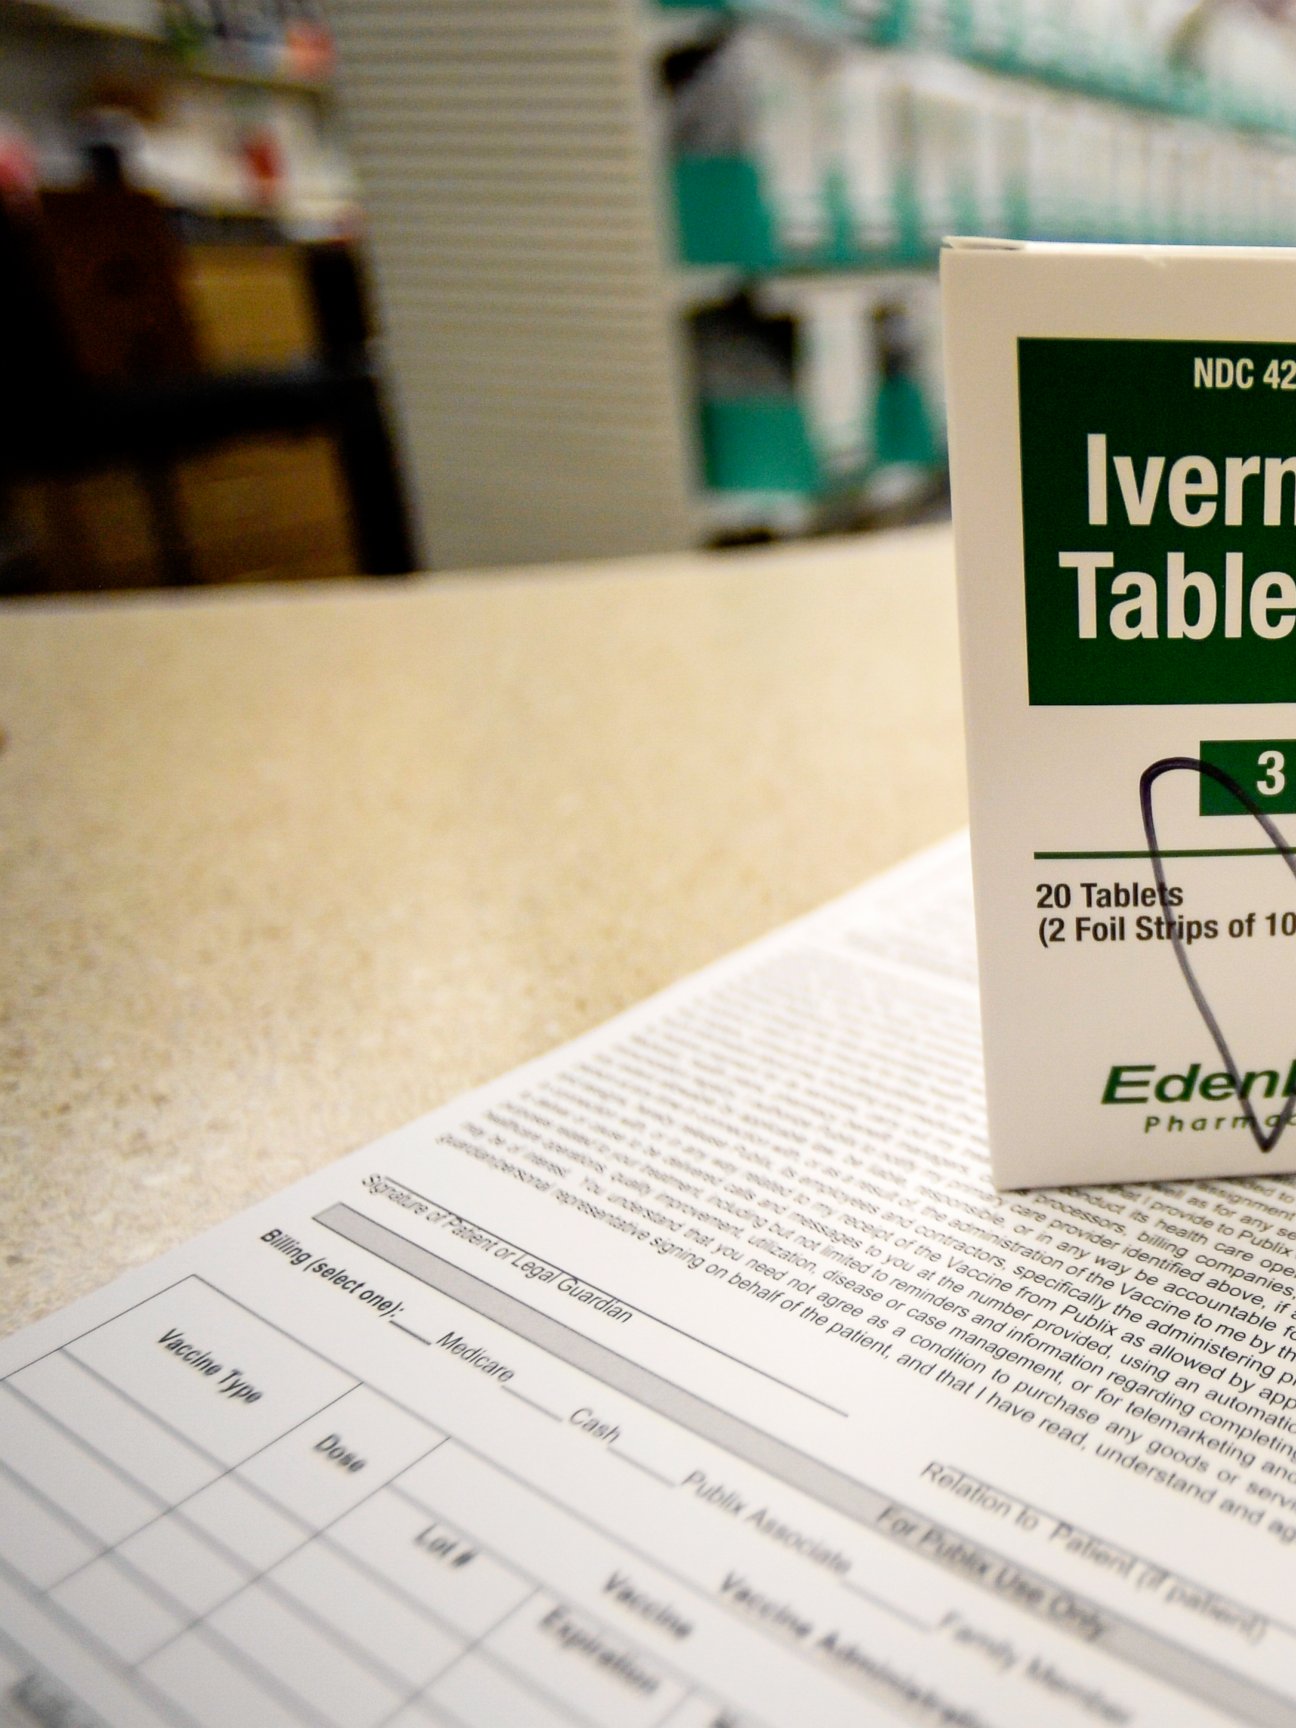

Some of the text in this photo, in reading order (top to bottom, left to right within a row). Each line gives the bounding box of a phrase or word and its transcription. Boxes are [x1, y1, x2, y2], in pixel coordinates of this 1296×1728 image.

[1193, 358, 1254, 389] NDC
[1257, 751, 1284, 797] 3
[1036, 882, 1184, 909] 20 Tablets
[1038, 918, 1066, 948] (2
[1075, 916, 1126, 942] Foil
[1135, 914, 1218, 945] Strips
[1228, 912, 1256, 938] of
[1265, 912, 1296, 937] 10
[362, 1172, 634, 1325] Signature of Patient or Legal Guardian
[1136, 1230, 1189, 1259] billing
[1194, 1253, 1296, 1300] companies,
[648, 1236, 706, 1270] signing
[704, 1263, 729, 1279] on
[726, 1271, 786, 1303] behalf
[779, 1298, 805, 1312] of
[798, 1305, 829, 1326] the
[824, 1321, 893, 1360] patient,
[895, 1353, 938, 1376] and
[934, 1368, 976, 1395] that
[984, 1390, 1036, 1423] have
[1084, 1270, 1115, 1290] the
[1119, 1281, 1191, 1320] Vaccine
[1192, 1312, 1213, 1329] to
[1213, 1323, 1247, 1342] me
[1248, 1333, 1277, 1355] by
[157, 1327, 263, 1406] Vaccine Type
[259, 1228, 312, 1266] Billing
[302, 1257, 366, 1294] (select
[358, 1289, 405, 1318] one):
[435, 1330, 515, 1383] Medicare
[568, 1407, 621, 1444] Cash
[680, 1469, 745, 1516] Publix
[746, 1507, 852, 1576] Associate
[821, 1269, 884, 1302] disease
[884, 1298, 907, 1311] or
[905, 1307, 947, 1330] case
[947, 1325, 1065, 1386] management,
[1070, 1379, 1094, 1394] or
[1093, 1386, 1124, 1407] for
[1124, 1400, 1257, 1469] telemarketing
[312, 1432, 368, 1474] Dose
[876, 1505, 917, 1538] For
[920, 1460, 1014, 1521] Relation
[1014, 1502, 1041, 1533] to
[1048, 1520, 1140, 1580] Patient
